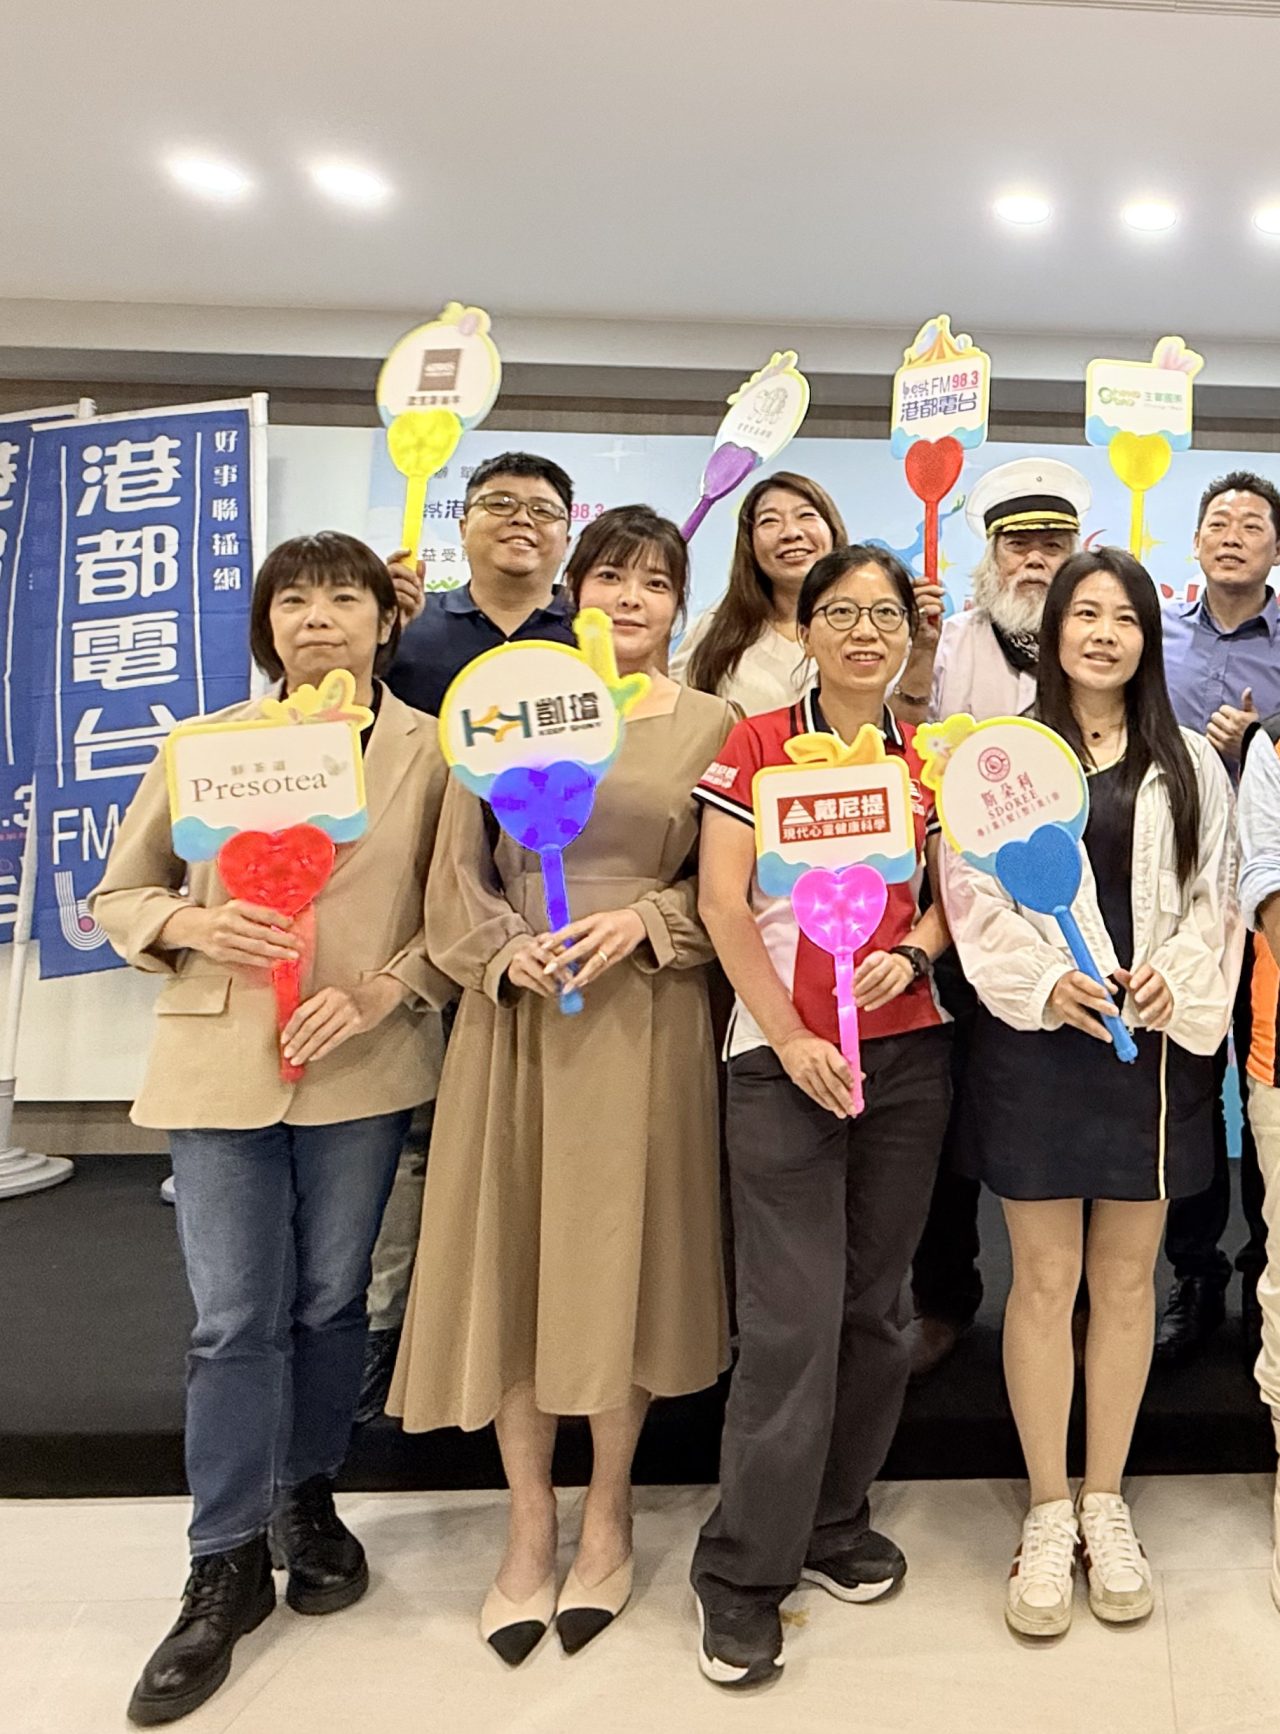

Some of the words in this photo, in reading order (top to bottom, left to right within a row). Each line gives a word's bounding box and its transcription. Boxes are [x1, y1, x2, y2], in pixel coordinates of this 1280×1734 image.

[900, 392, 978, 422] 港都電台
[211, 430, 242, 592] 好事聯播網
[71, 434, 183, 782] 港都電台
[190, 772, 327, 802] Presotea
[813, 793, 885, 821] 戴尼提
[988, 789, 1038, 819] SDOREE
[783, 818, 886, 841] 現代心靈健康科學
